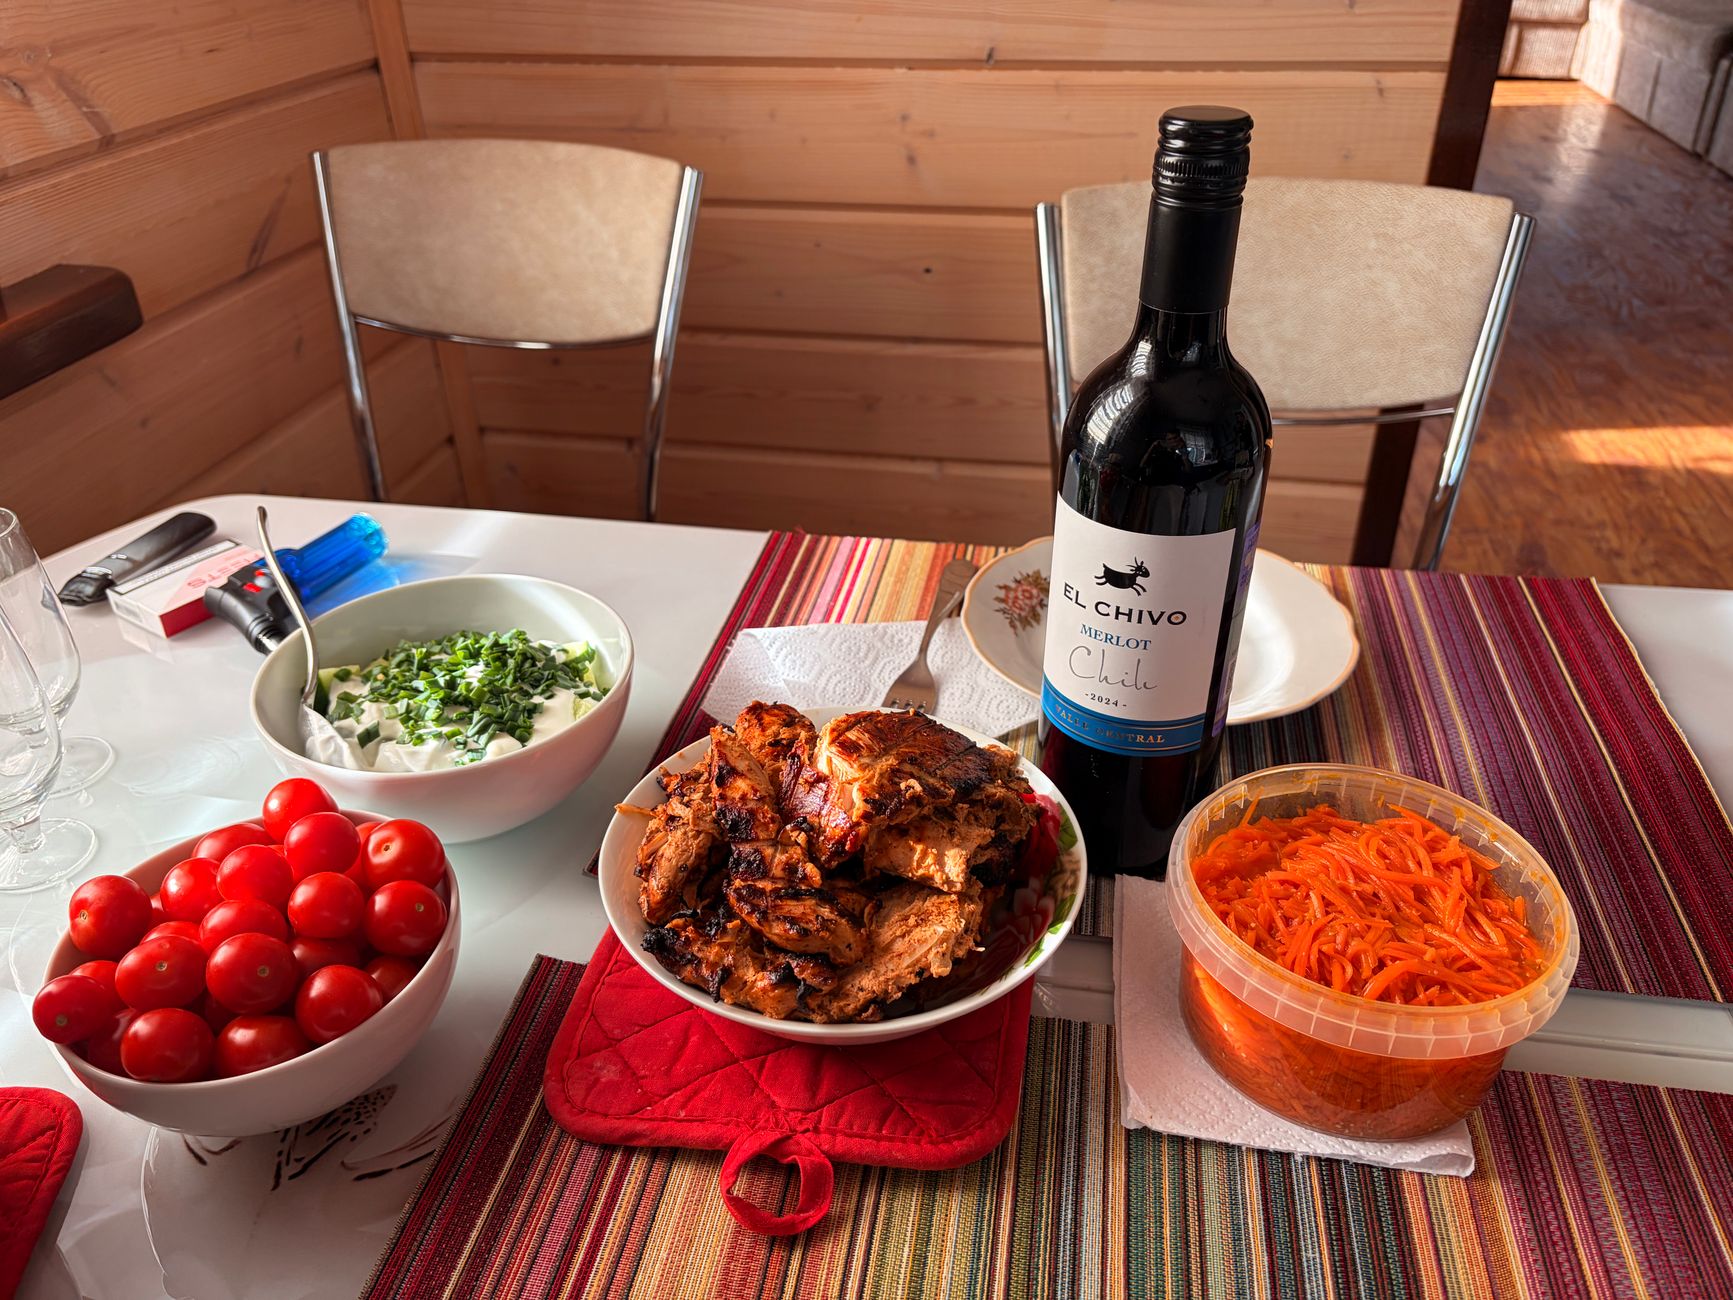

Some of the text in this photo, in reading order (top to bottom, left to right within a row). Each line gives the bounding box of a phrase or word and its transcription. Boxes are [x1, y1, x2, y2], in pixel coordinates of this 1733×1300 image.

[1063, 582, 1187, 625] EL CHIVO
[1080, 624, 1152, 651] MERLOT
[1069, 645, 1157, 691] Chile
[1055, 704, 1165, 744] VALLE CENTRAL
